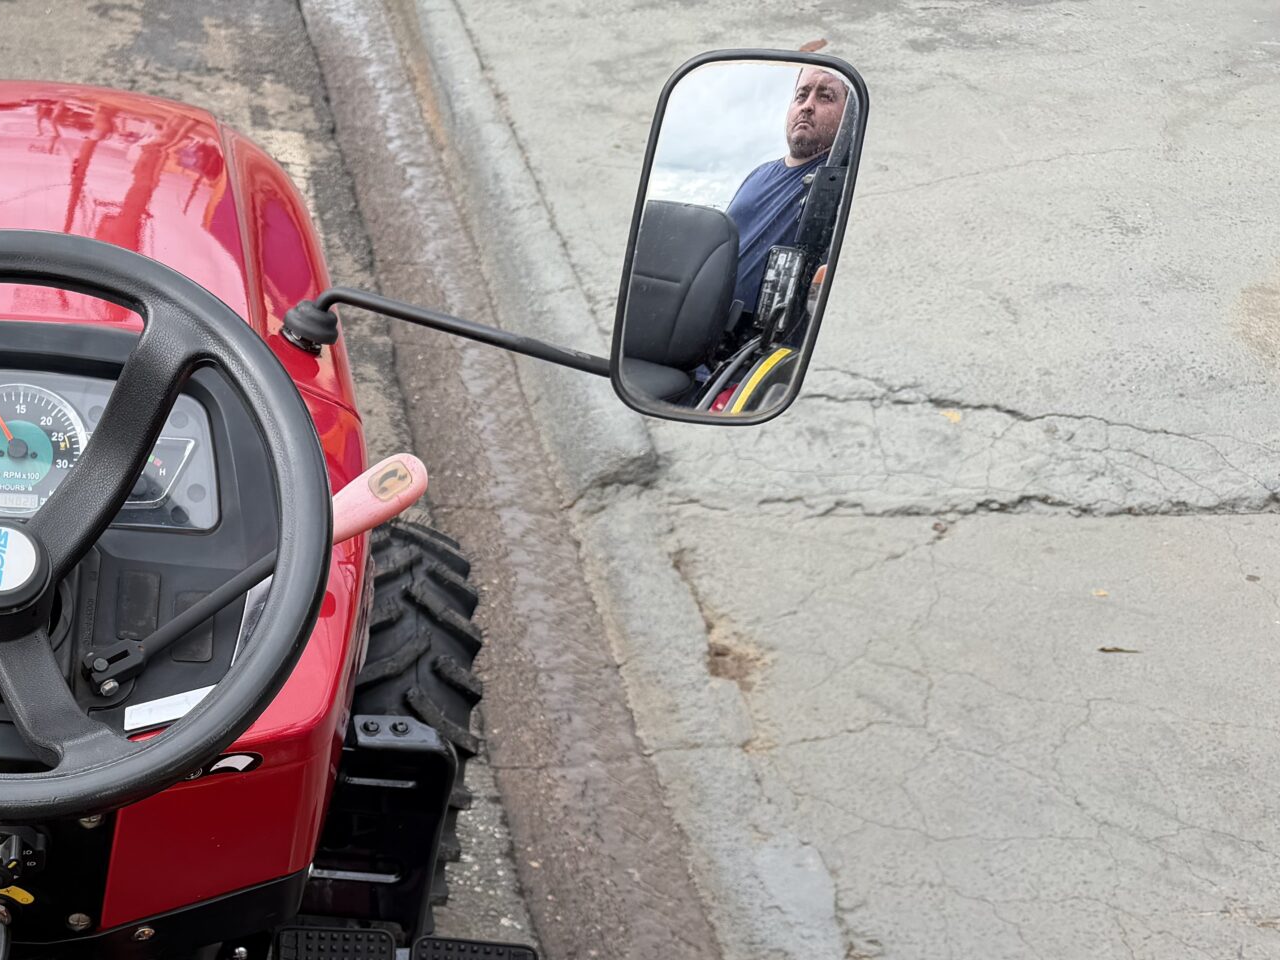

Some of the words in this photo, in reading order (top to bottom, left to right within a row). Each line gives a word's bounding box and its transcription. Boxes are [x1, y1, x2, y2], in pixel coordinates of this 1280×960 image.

[16, 404, 26, 413] 15
[41, 416, 52, 425] 20
[51, 432, 64, 441] 25
[56, 460, 68, 468] 30
[159, 468, 166, 476] H
